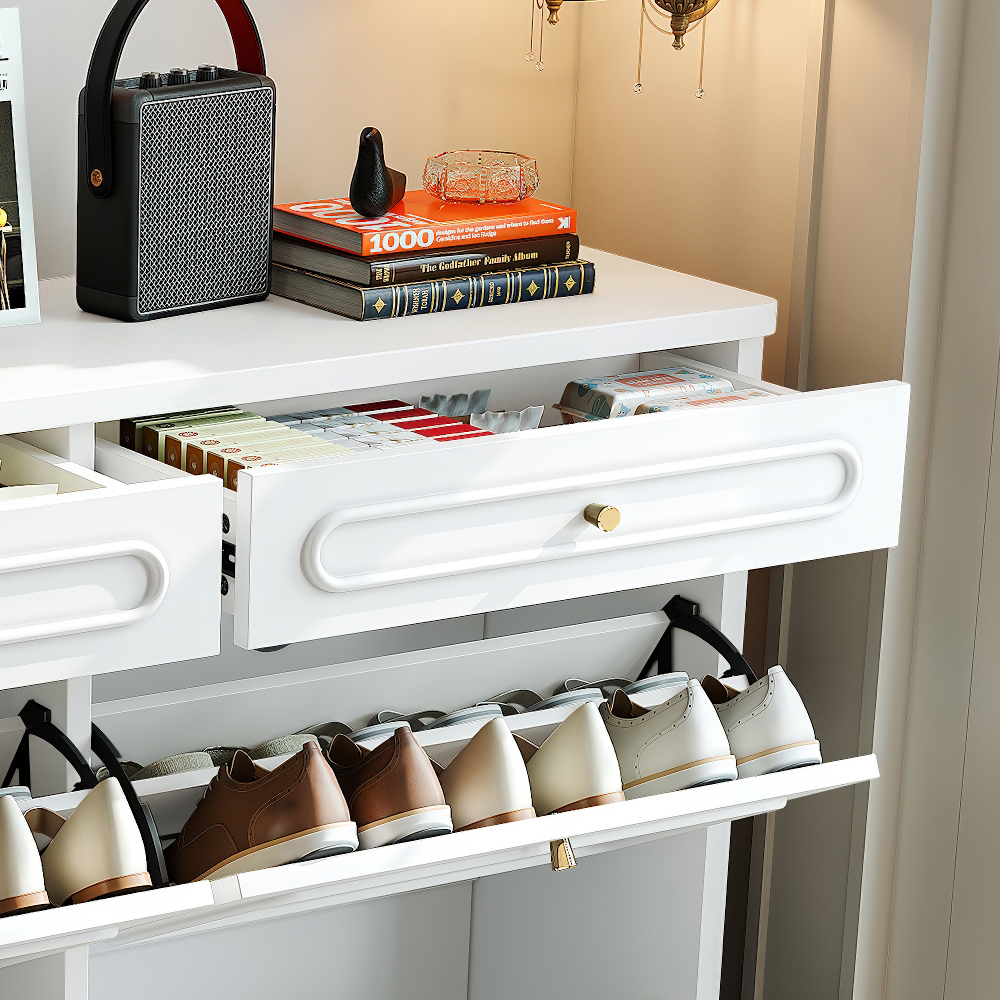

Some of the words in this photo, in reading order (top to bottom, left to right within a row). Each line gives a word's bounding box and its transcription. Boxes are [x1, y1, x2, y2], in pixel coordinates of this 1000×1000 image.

[369, 228, 434, 253] 1000
[420, 264, 437, 273] The
[439, 258, 481, 271] Godfather
[484, 254, 511, 265] Family
[513, 252, 538, 262] Album
